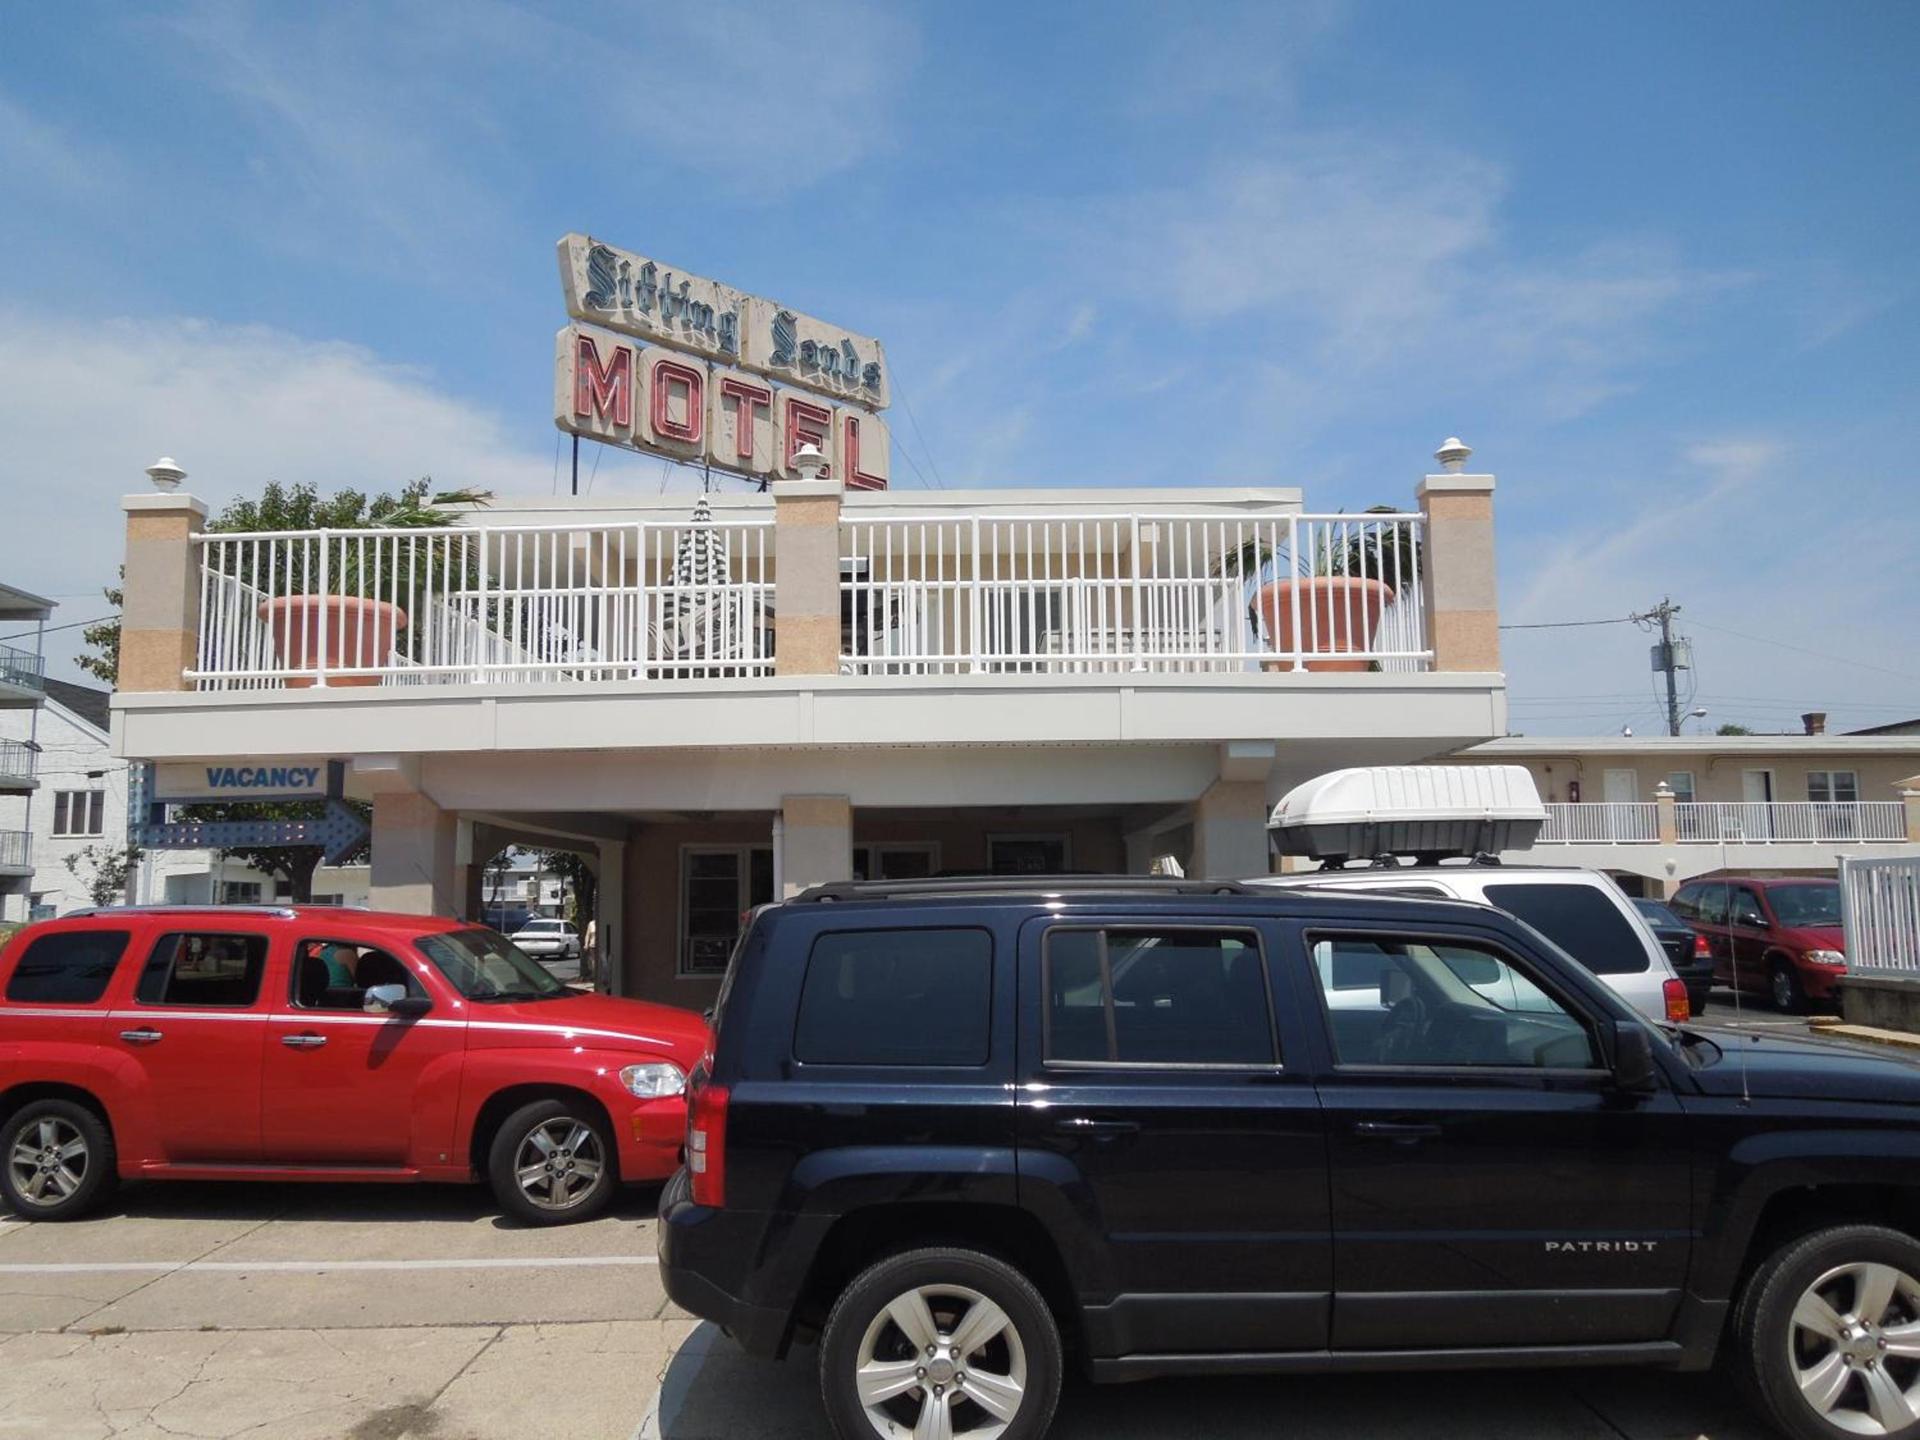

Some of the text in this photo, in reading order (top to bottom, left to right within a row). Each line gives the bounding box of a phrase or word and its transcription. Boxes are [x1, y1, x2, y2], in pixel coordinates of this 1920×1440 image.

[769, 310, 881, 387] Sands
[574, 334, 888, 491] MOTEL
[206, 767, 320, 788] VACANCY
[1545, 1241, 1657, 1252] PATRIOT
